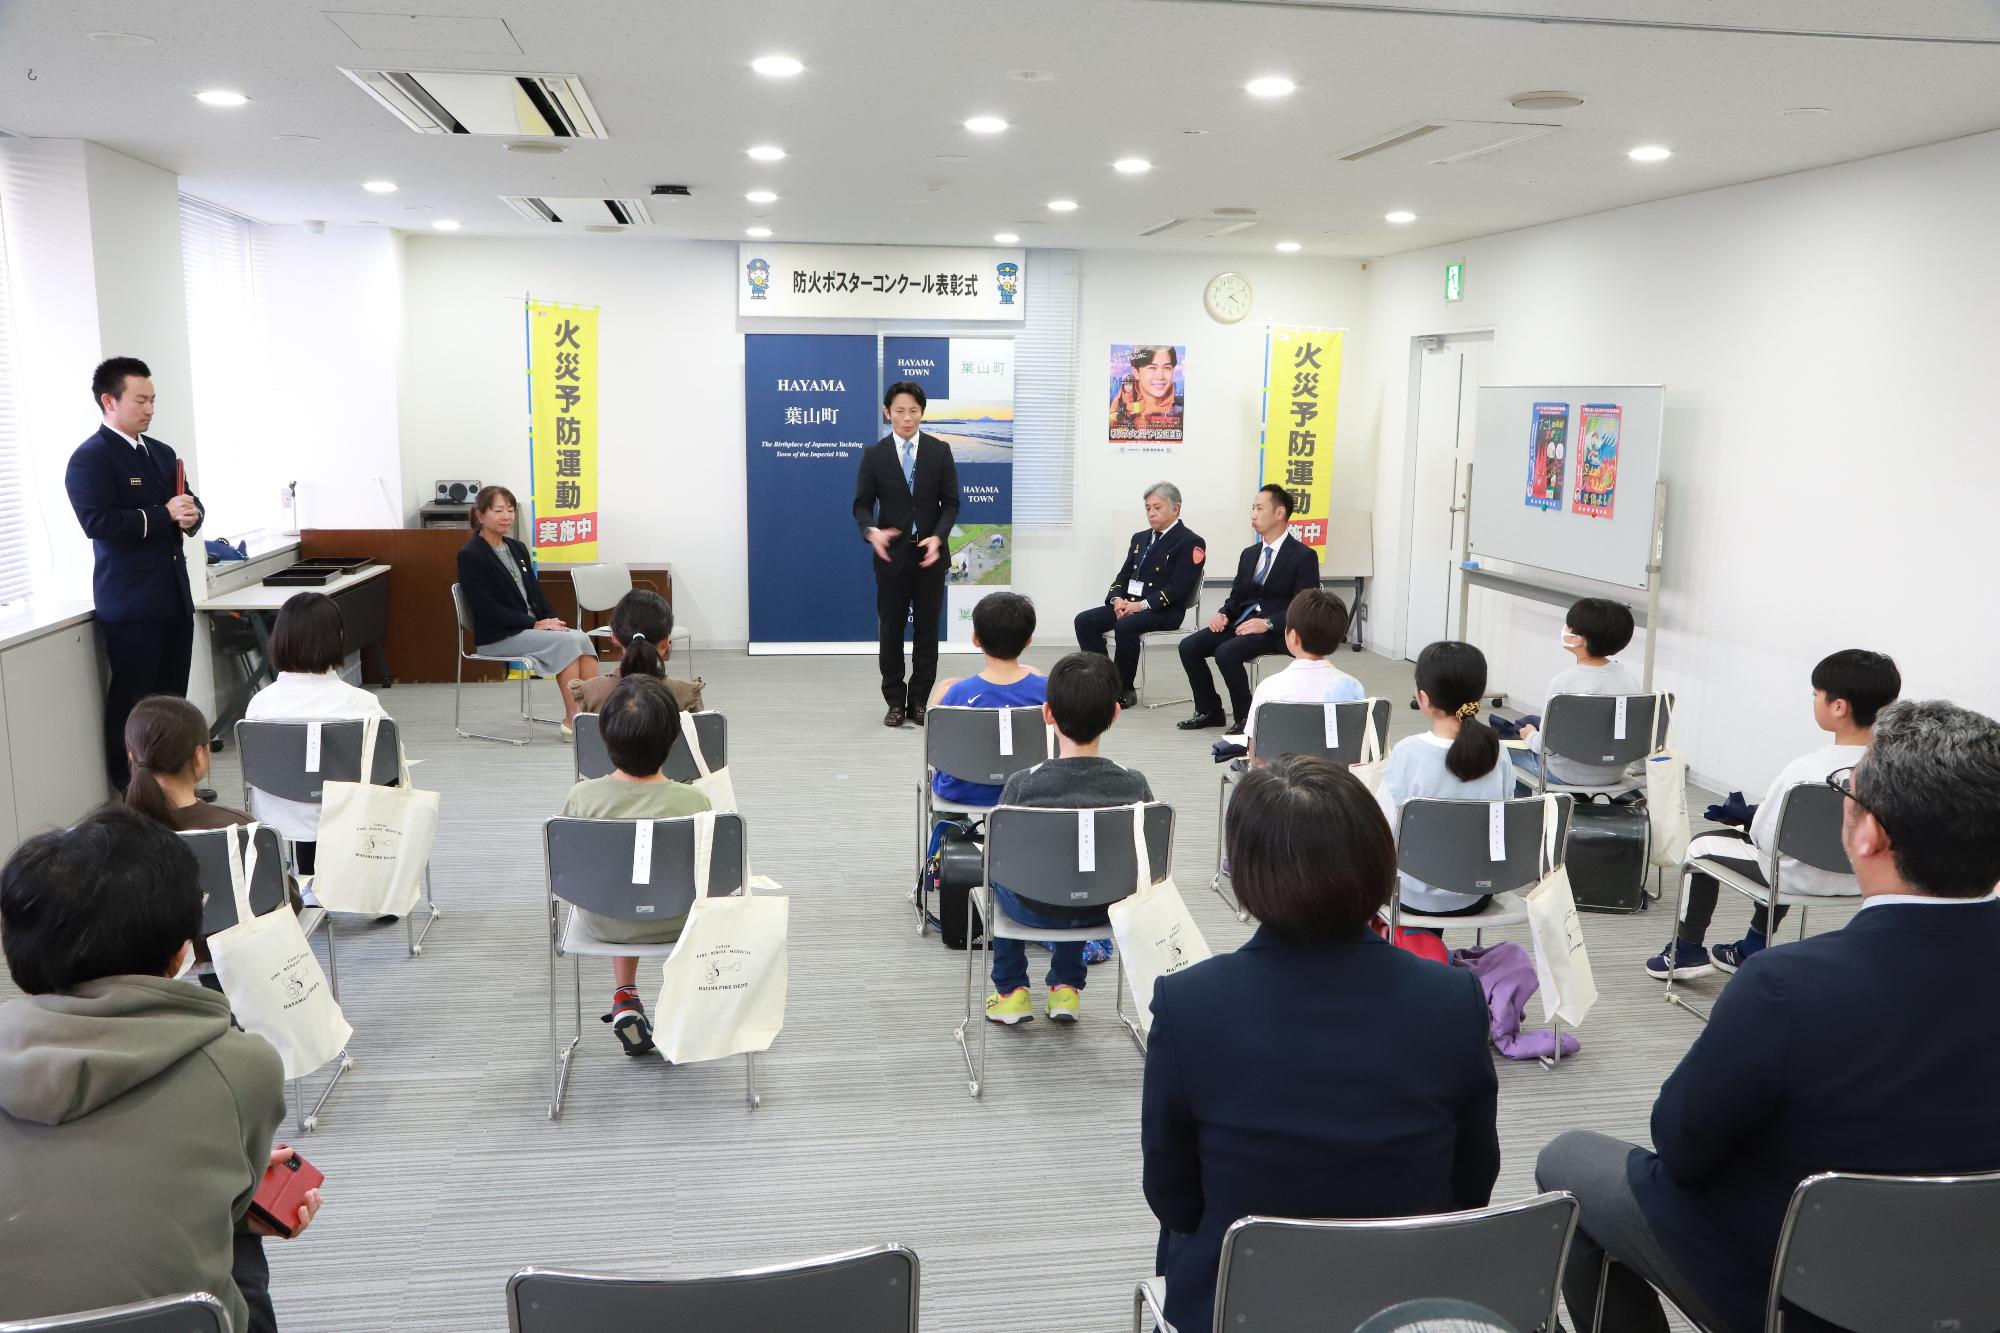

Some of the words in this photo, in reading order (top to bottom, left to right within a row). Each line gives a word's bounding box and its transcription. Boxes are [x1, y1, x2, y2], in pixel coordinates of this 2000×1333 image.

[793, 270, 978, 297] 防火ポスターコンクール表彰式
[898, 359, 935, 367] HAYAMA
[961, 360, 1006, 375] 葉山町
[903, 368, 930, 376] TOWN
[777, 379, 846, 392] HAYAMA
[554, 319, 581, 510] 火災予防運動
[784, 406, 840, 425] 葉山町
[1285, 342, 1323, 515] 火災予防運動
[773, 441, 803, 449] Birthplace
[803, 441, 811, 449] of
[811, 441, 838, 449] Japanese
[839, 441, 864, 449] Yachting
[792, 451, 799, 459] of
[809, 451, 834, 459] Imperial
[963, 486, 999, 494] HAYAMA
[968, 495, 994, 503] TOWN
[539, 518, 592, 544] 実施中
